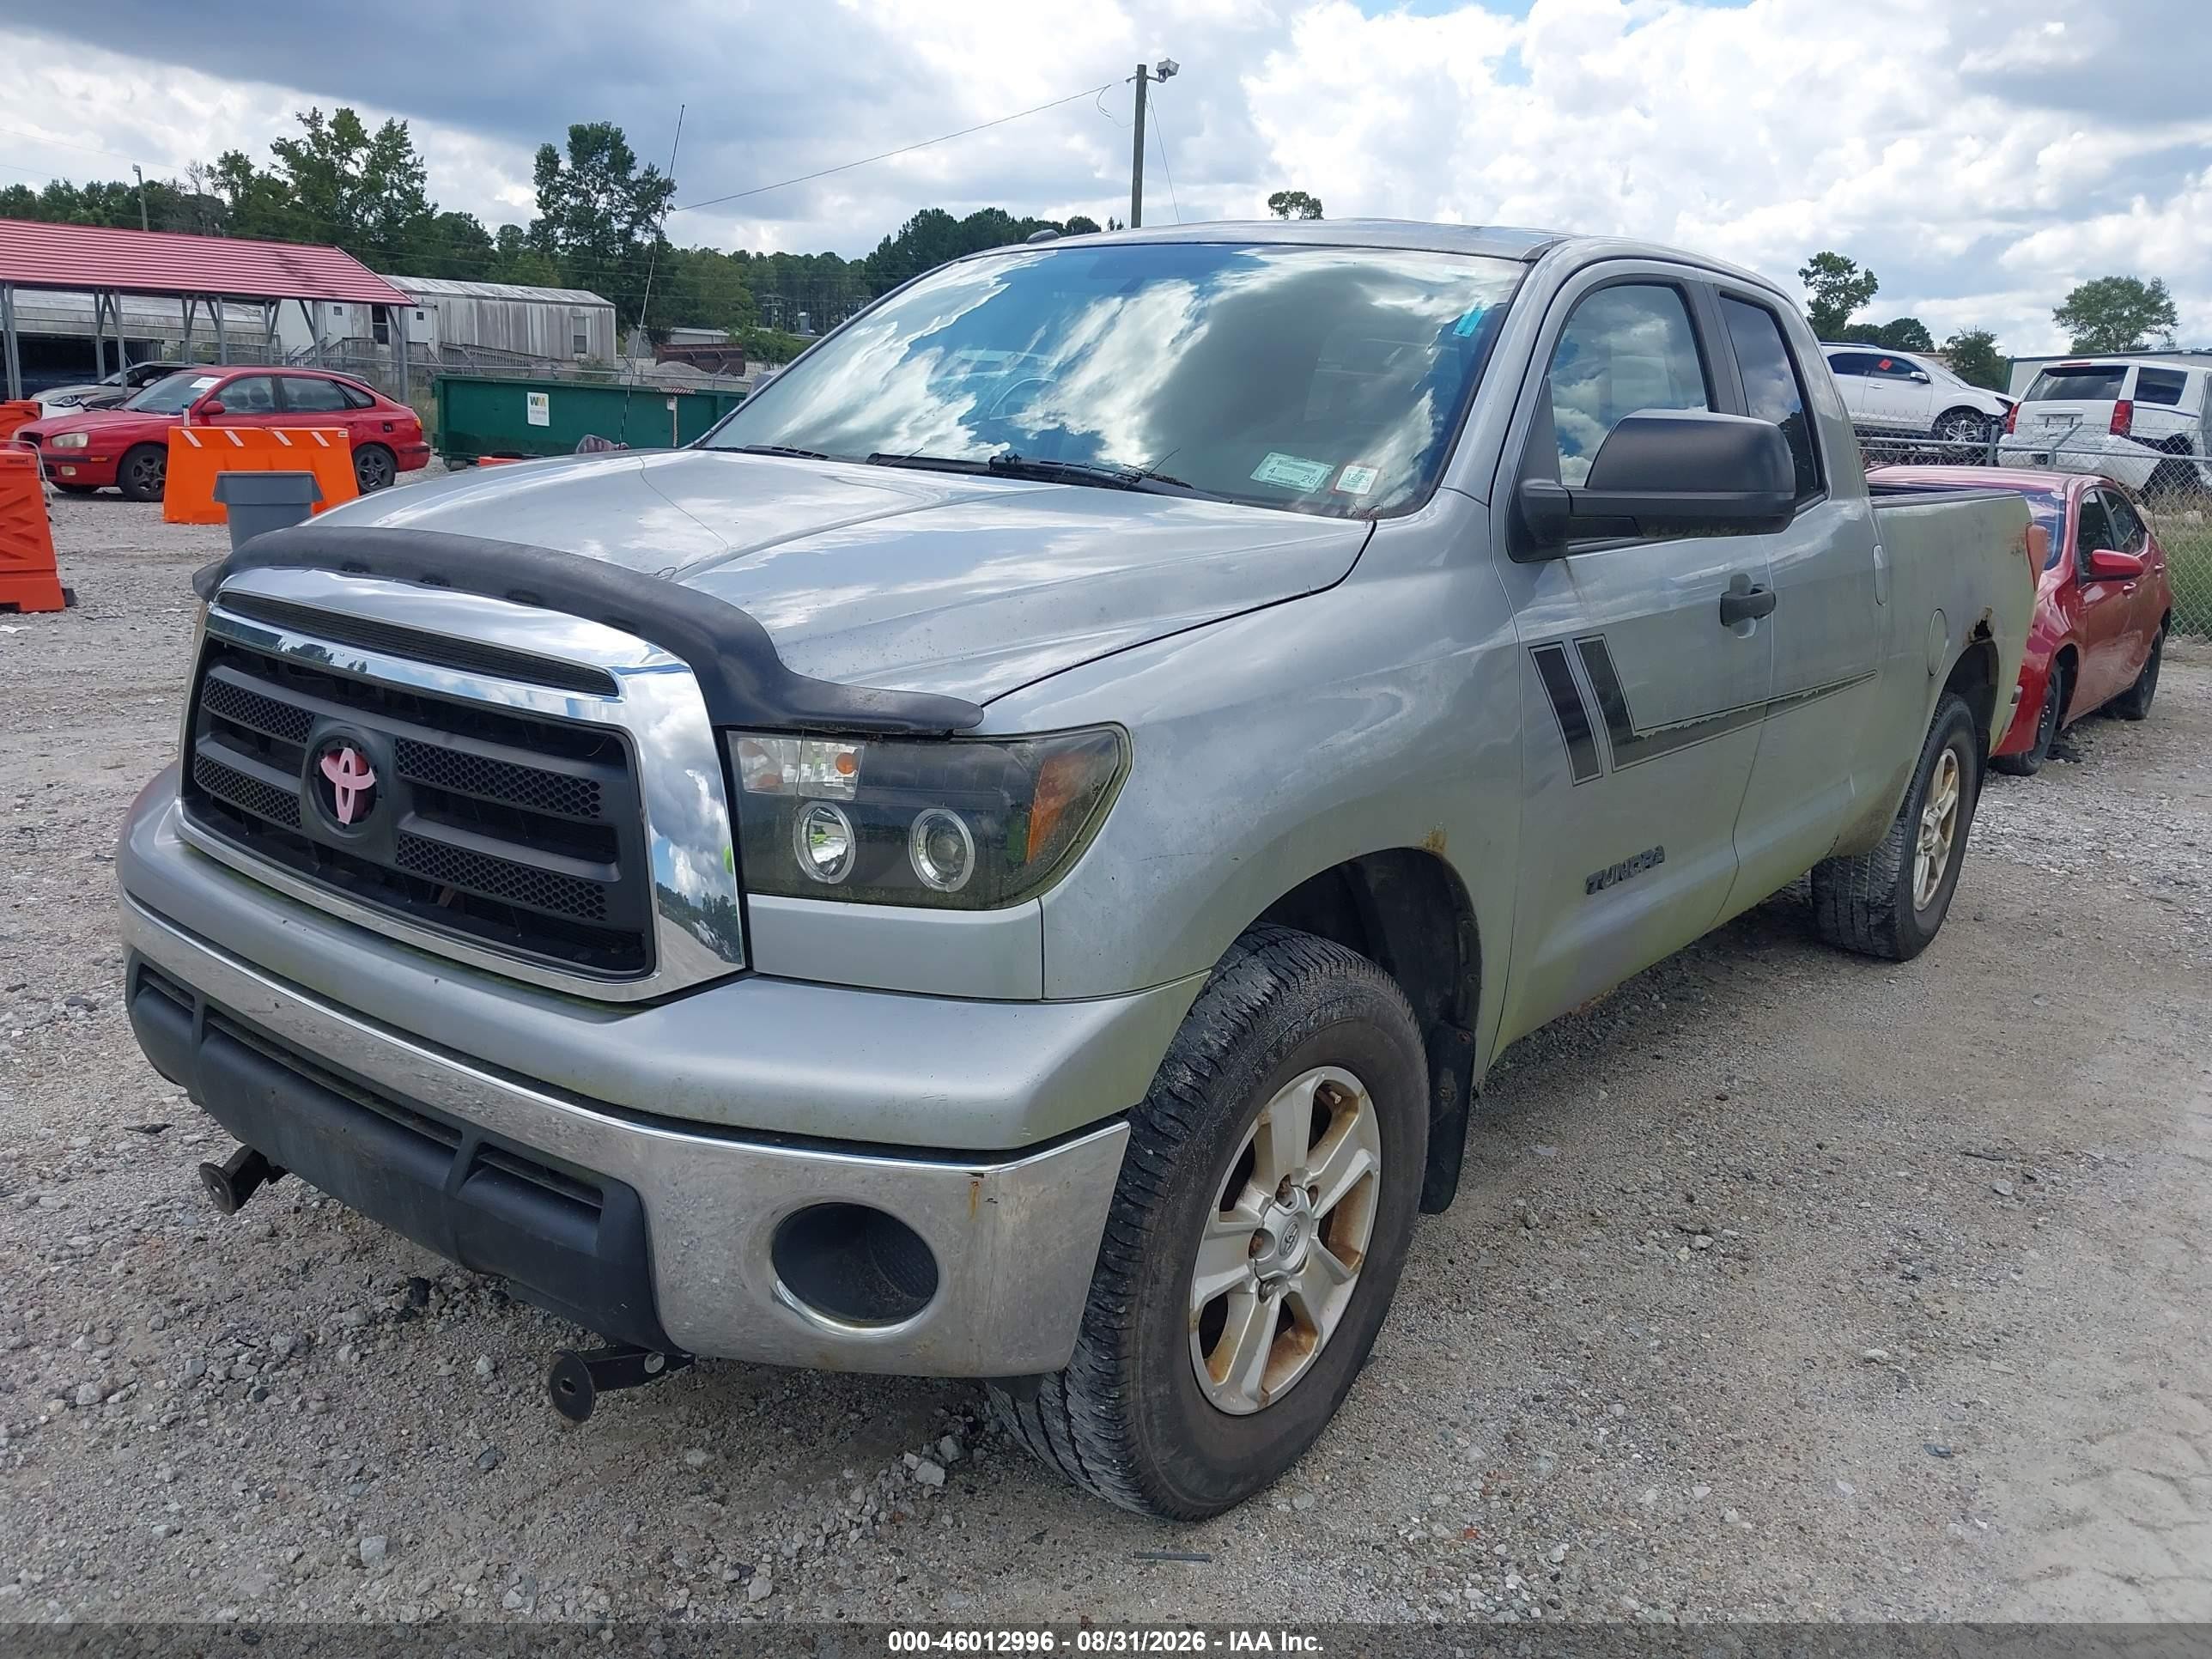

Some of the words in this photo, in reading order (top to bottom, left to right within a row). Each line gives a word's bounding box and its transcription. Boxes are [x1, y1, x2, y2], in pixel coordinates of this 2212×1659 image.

[529, 396, 547, 407] WM
[1300, 474, 1318, 485] 26
[1585, 845, 1666, 895] TUNDRA
